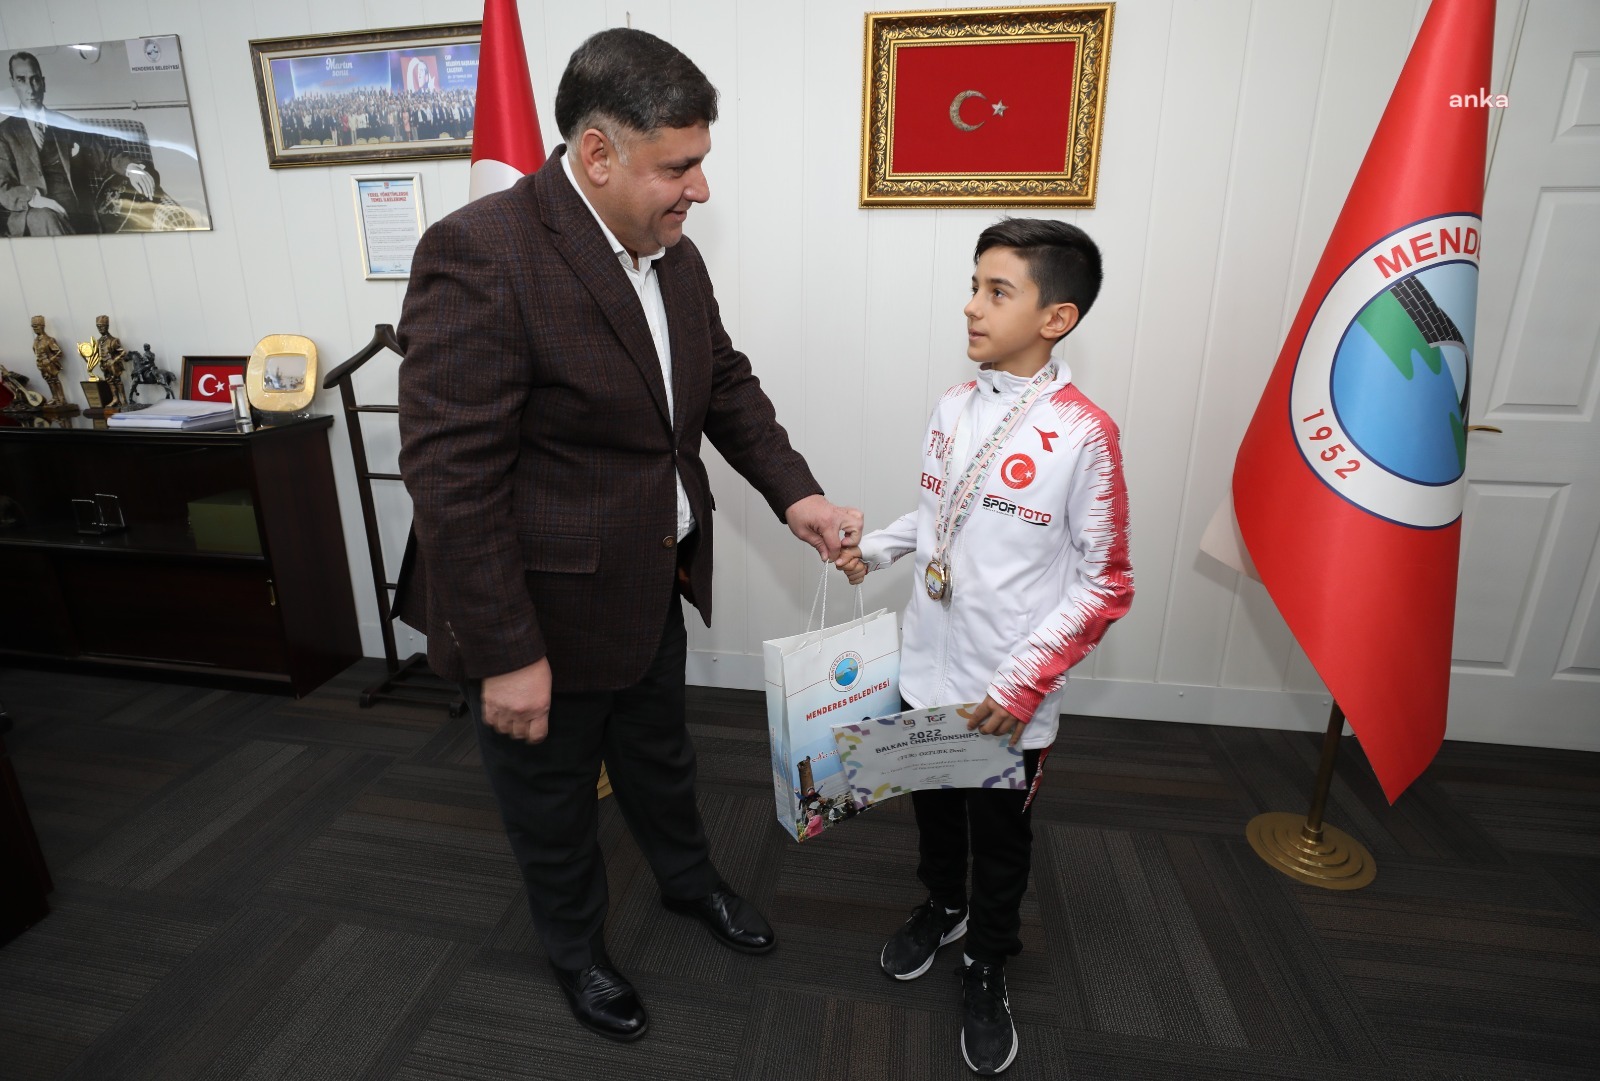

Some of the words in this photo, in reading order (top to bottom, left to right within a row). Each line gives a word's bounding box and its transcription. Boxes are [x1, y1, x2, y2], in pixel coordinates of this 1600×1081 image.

[1303, 408, 1361, 480] 1952
[805, 698, 848, 721] MENDERES
[848, 677, 890, 703] BELEDİYESİ
[875, 741, 908, 754] BALKAN
[910, 732, 980, 745] CHAMPIONSHIPS
[908, 728, 942, 740] 2022
